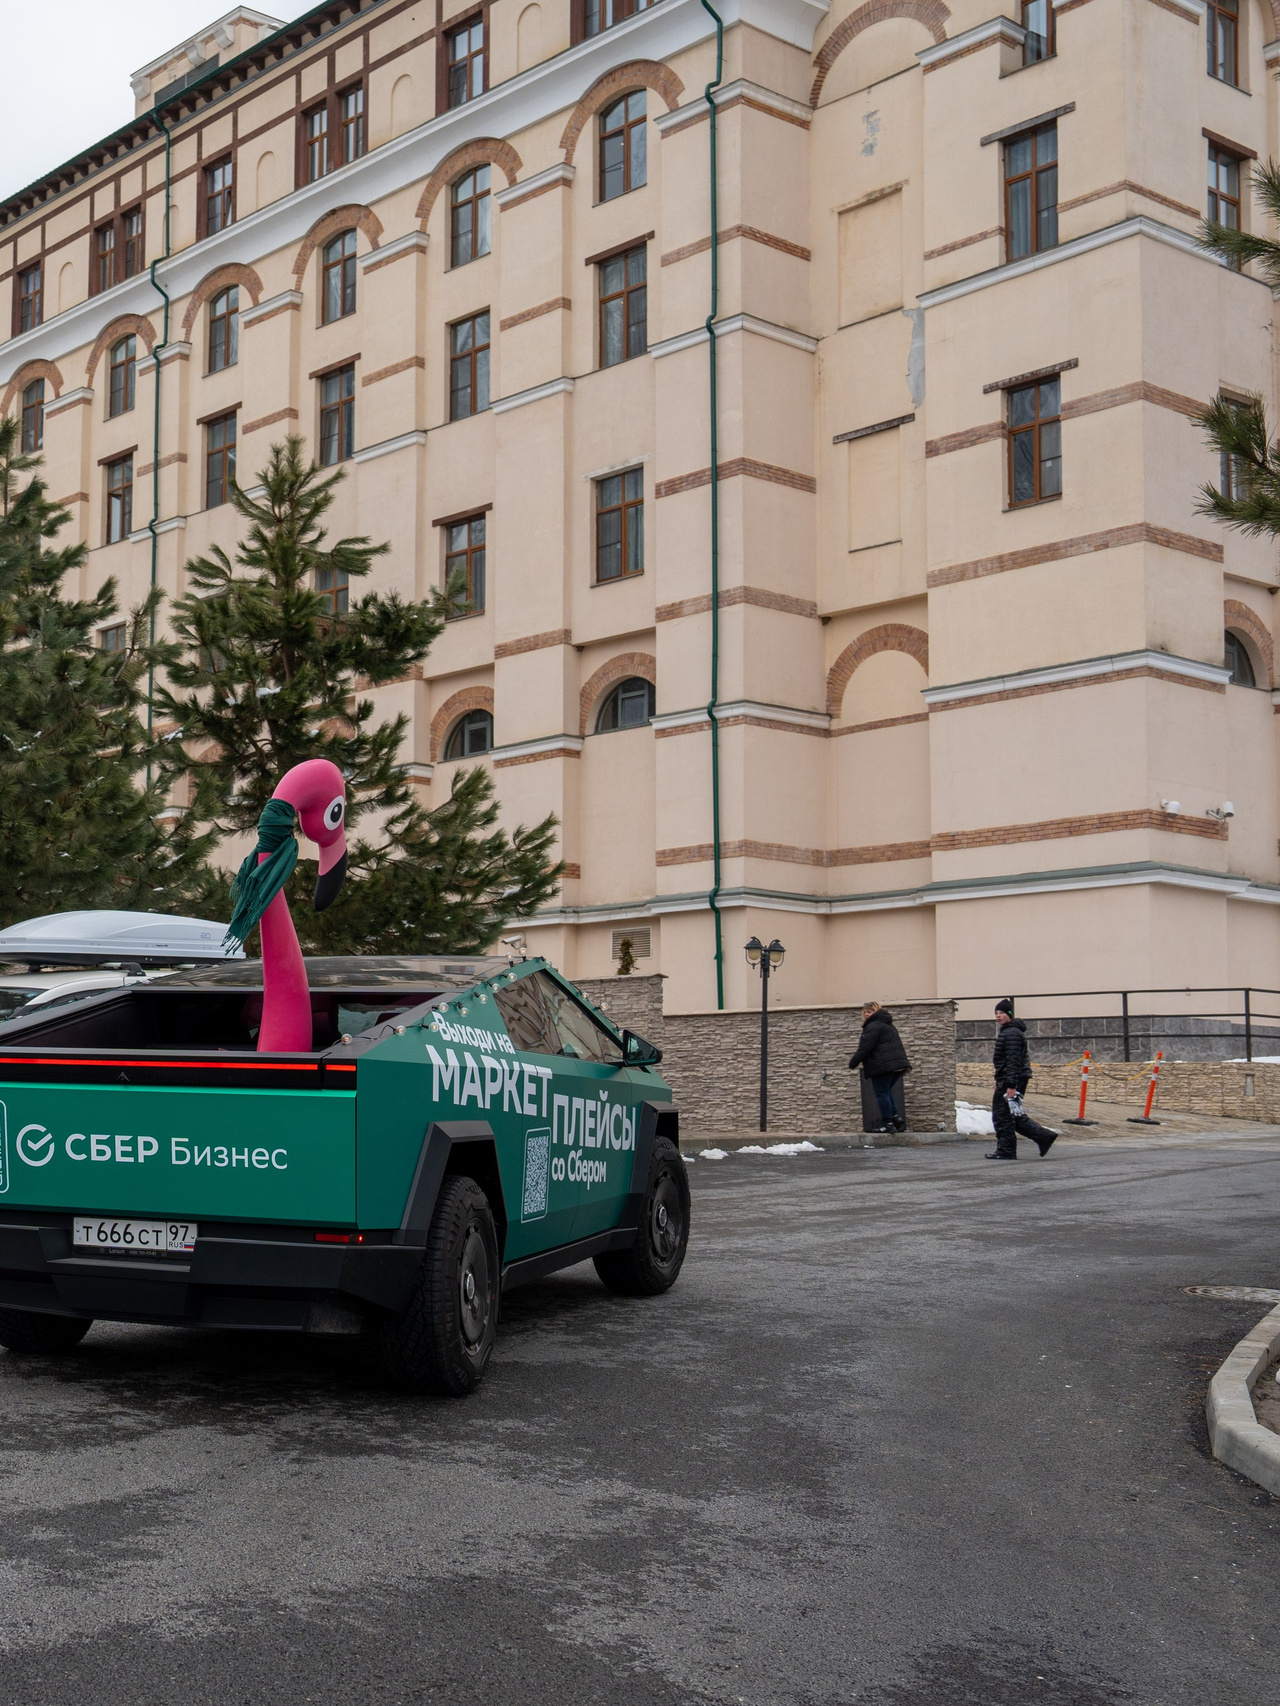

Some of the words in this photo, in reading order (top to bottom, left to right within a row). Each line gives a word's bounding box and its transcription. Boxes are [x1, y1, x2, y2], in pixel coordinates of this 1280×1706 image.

[432, 1011, 497, 1054] Выходи
[493, 1032, 516, 1055] на
[425, 1044, 553, 1118] МАРКЕТ
[552, 1090, 637, 1152] ПЛЕЙСЫ
[65, 1133, 159, 1163] СБЕР
[171, 1137, 288, 1170] Бизнес
[551, 1156, 565, 1182] со
[567, 1149, 607, 1190] Сбером
[168, 1241, 184, 1249] RUS
[169, 1224, 189, 1241] 97
